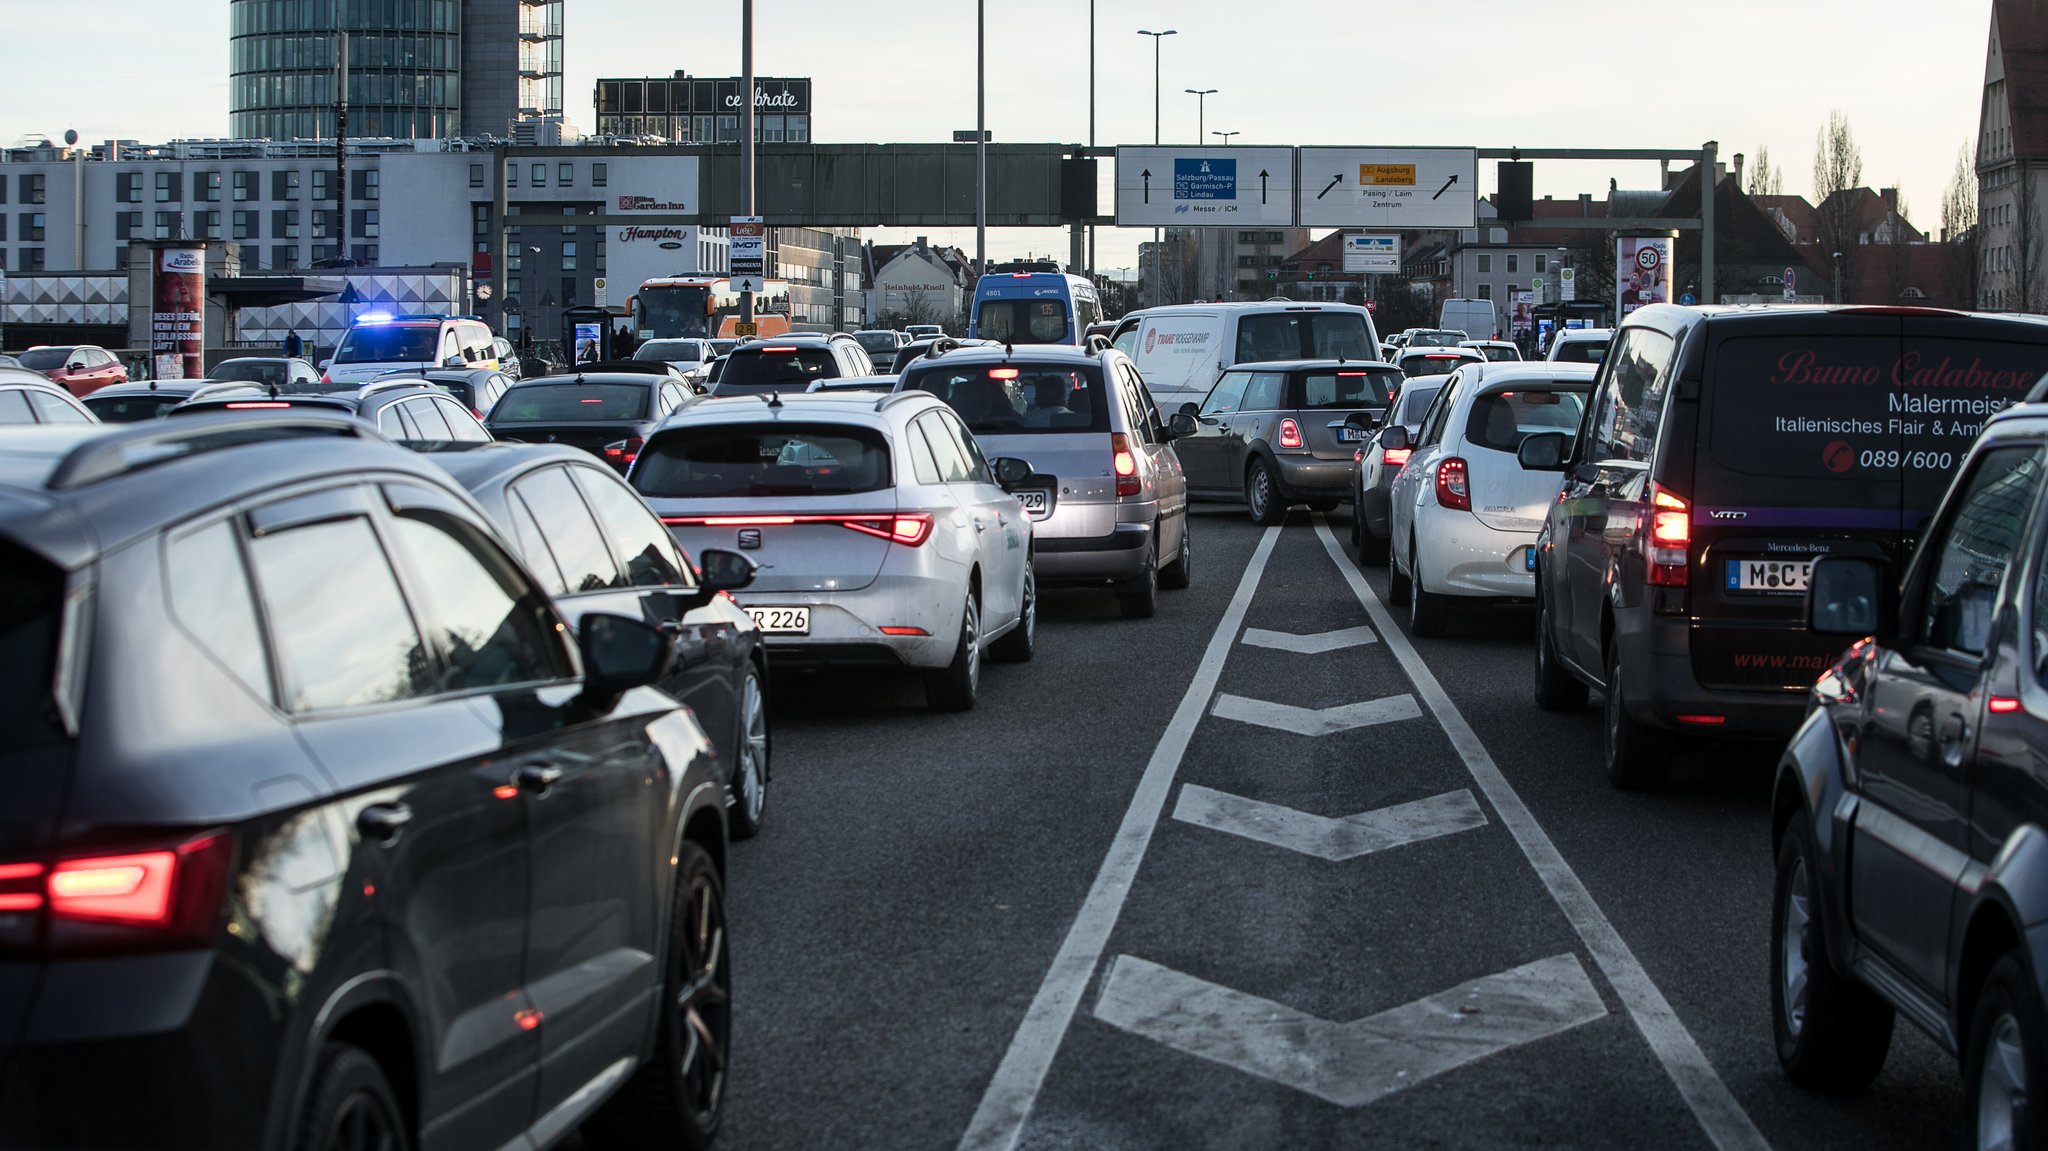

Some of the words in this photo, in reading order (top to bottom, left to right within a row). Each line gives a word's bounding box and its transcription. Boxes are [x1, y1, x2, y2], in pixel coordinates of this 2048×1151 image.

[725, 87, 798, 106] cebrate
[1176, 174, 1234, 182] Salzburg/Passau
[1363, 190, 1386, 198] Pasing
[620, 226, 686, 242] Hampton
[1642, 253, 1656, 264] 50
[1040, 304, 1053, 314] 135
[1770, 349, 1880, 385] Bruno
[1890, 351, 2034, 389] Calabrese
[1776, 416, 1882, 434] Italienisches
[1888, 419, 1925, 435] Flair
[1932, 421, 1944, 436] &
[1860, 450, 1952, 469] 089/600
[1710, 511, 1747, 519] VITO
[1768, 543, 1830, 552] Mercedes-Benz
[1750, 564, 1764, 586] M
[1782, 564, 1795, 586] C
[770, 611, 805, 628] 226
